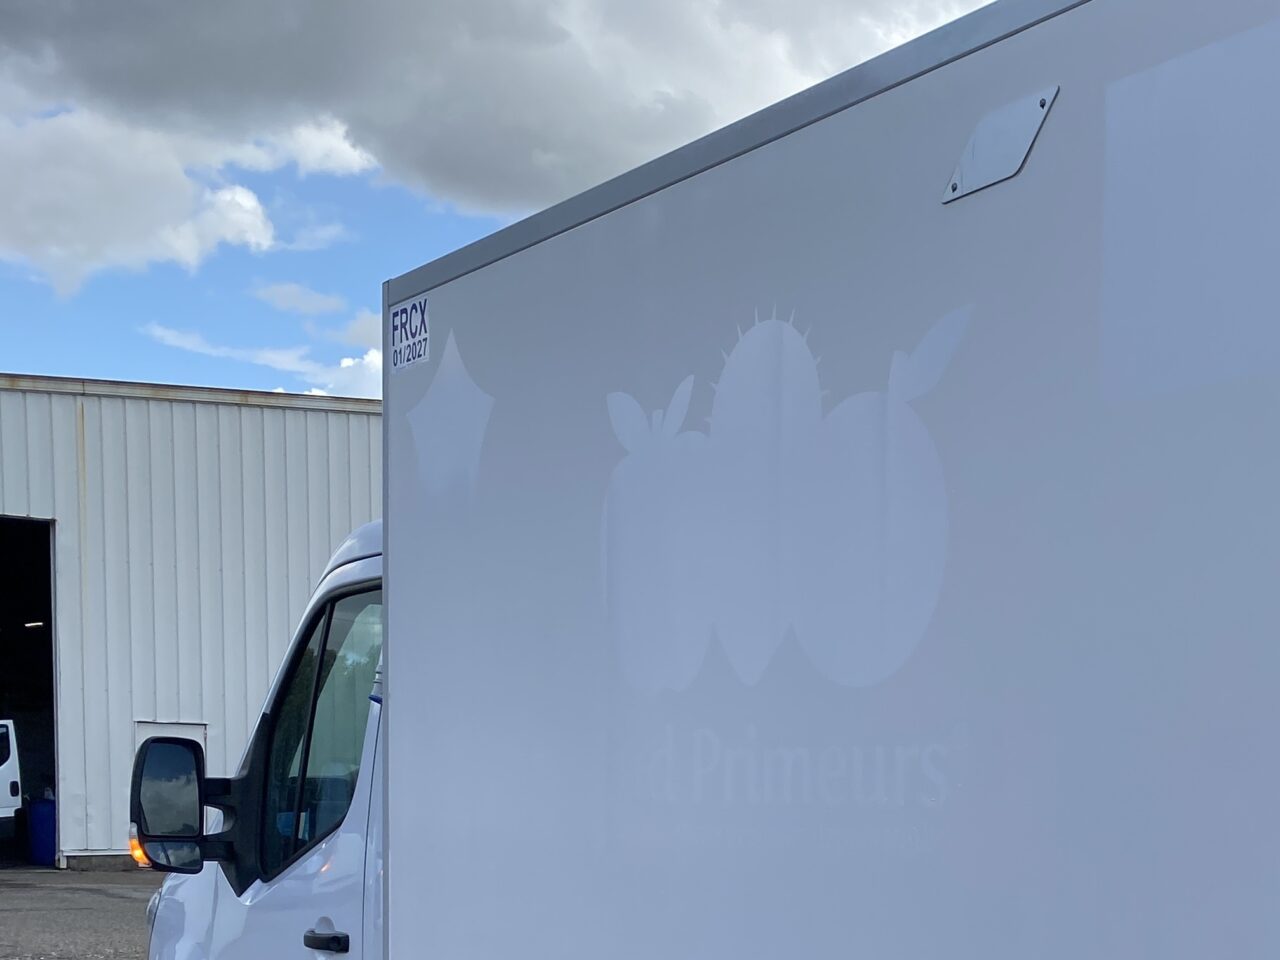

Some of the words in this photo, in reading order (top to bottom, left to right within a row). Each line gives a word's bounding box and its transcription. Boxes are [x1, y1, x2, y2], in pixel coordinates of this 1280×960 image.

[392, 298, 428, 347] FRCX
[392, 337, 428, 367] 01/2027
[691, 722, 950, 809] Primeurs
